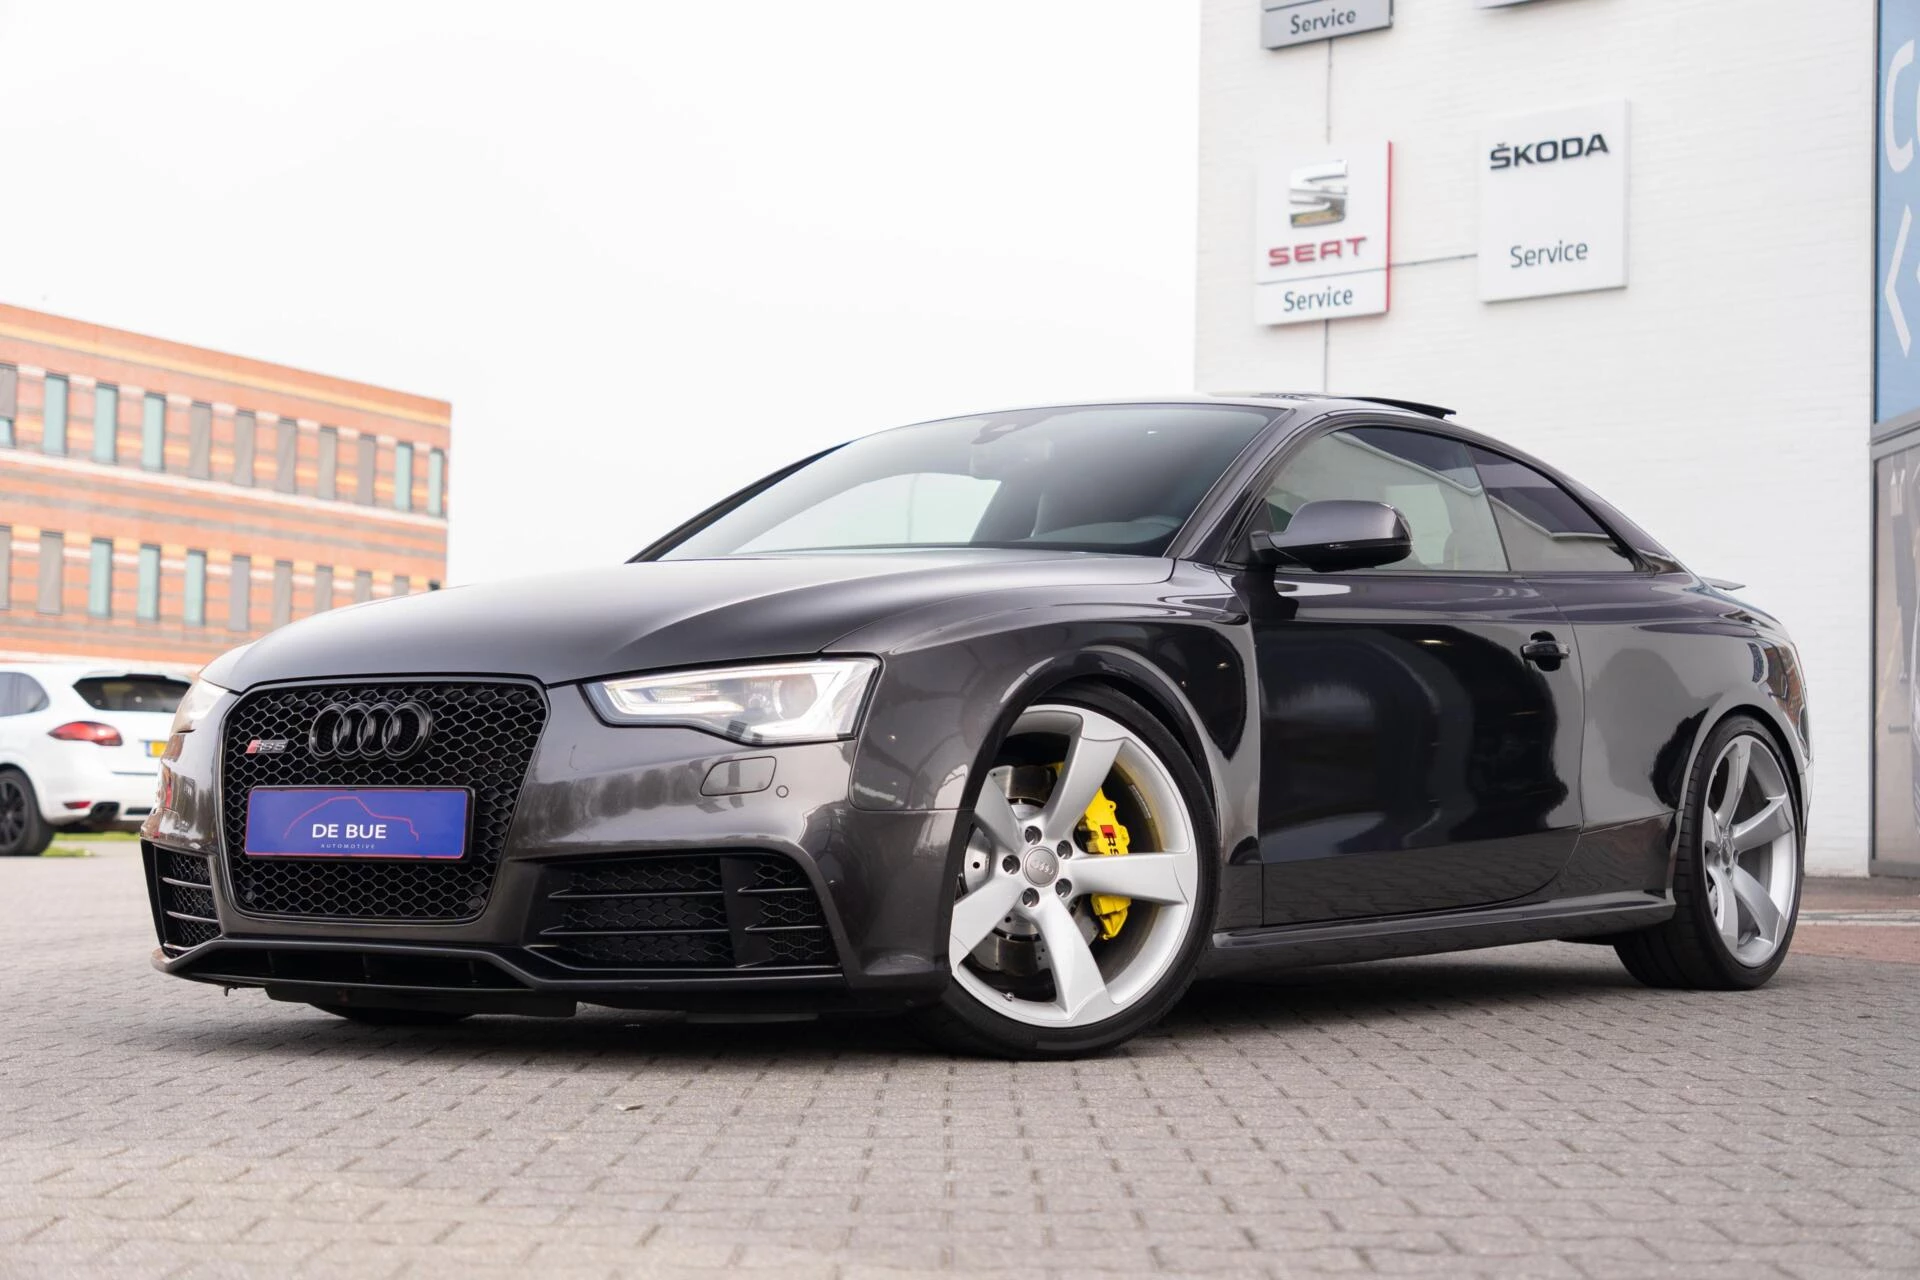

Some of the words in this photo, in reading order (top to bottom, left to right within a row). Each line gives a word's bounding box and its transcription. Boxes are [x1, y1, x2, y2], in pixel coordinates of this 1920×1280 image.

[1290, 8, 1357, 35] Service
[1489, 133, 1610, 170] ŠKODA
[1269, 236, 1368, 267] SEAT
[1509, 239, 1589, 270] Service
[1283, 285, 1354, 313] Service
[312, 823, 339, 839] DE
[345, 823, 387, 839] BUE
